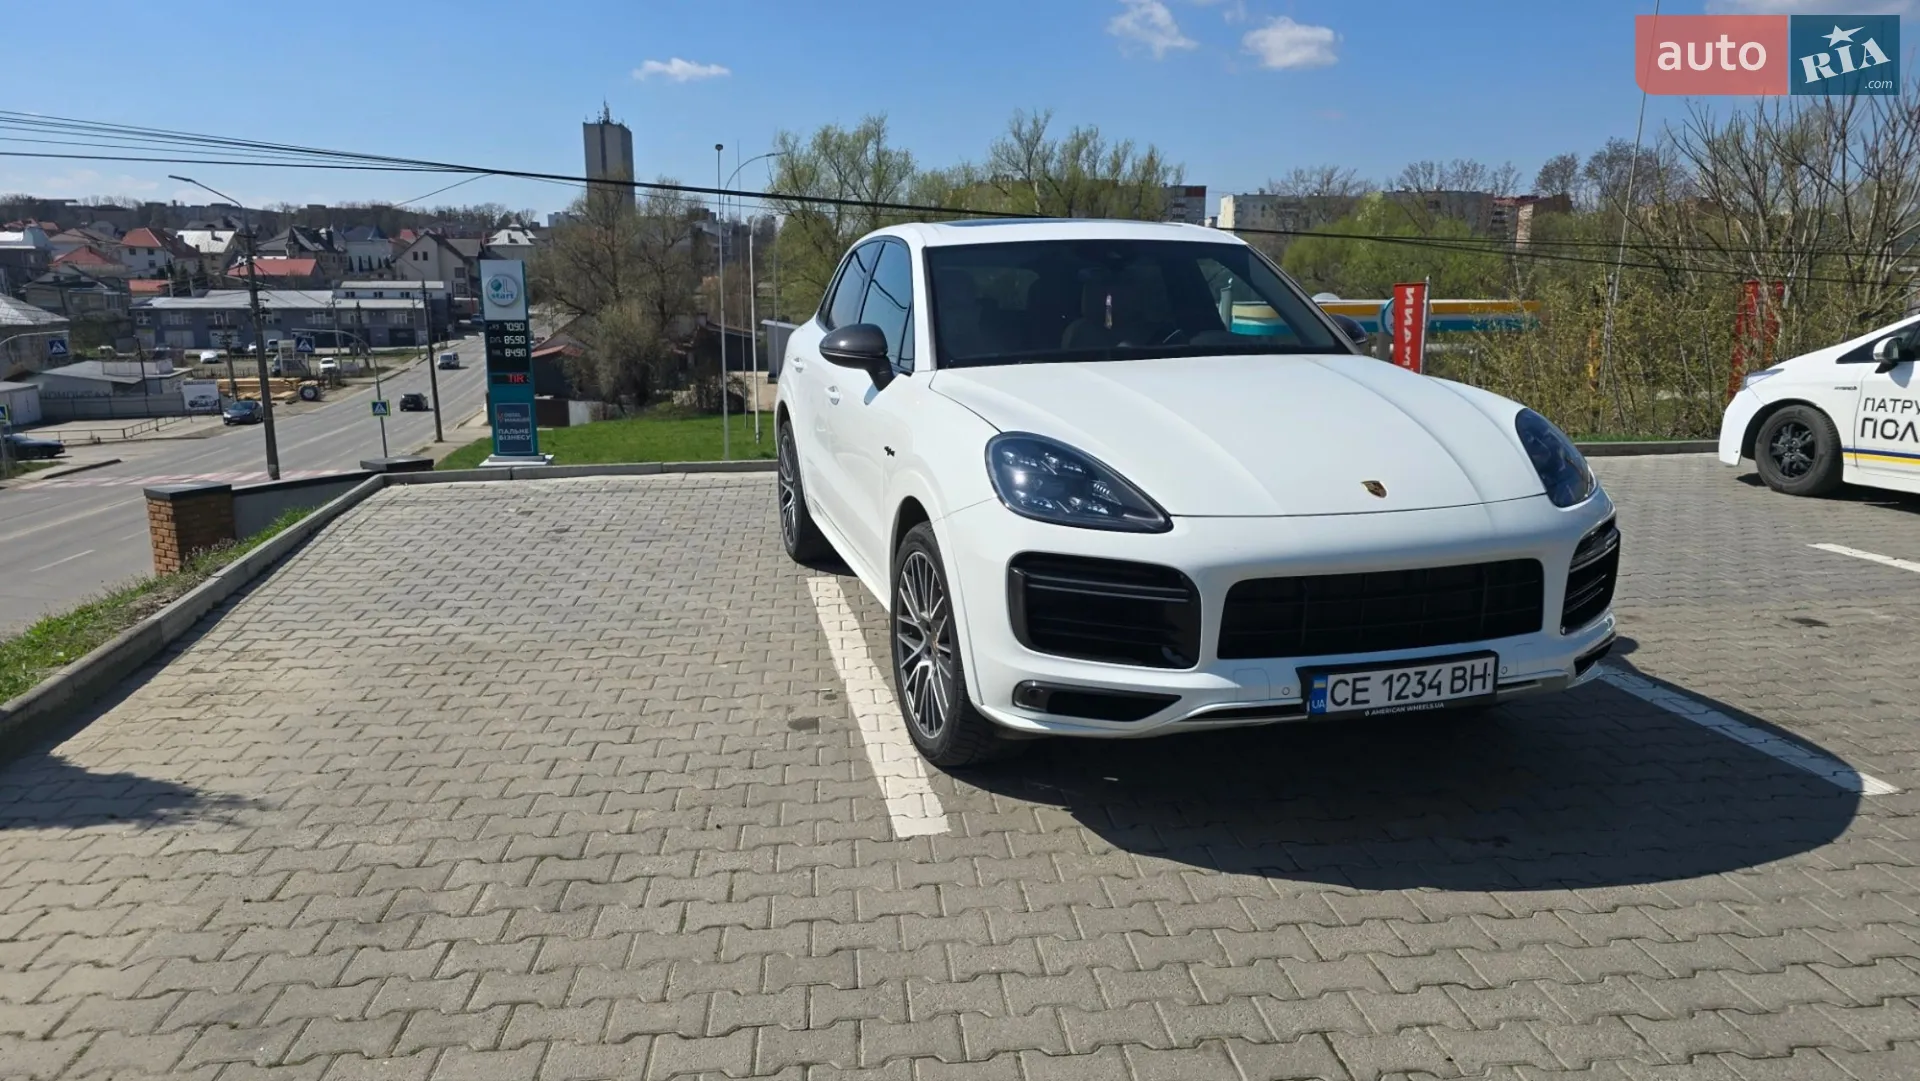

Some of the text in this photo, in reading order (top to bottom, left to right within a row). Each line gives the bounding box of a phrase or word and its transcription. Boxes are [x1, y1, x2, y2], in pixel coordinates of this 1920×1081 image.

[1861, 417, 1919, 443] ПОЛ
[1330, 662, 1488, 707] CE 1234 BH
[1312, 697, 1326, 709] UA
[1370, 706, 1405, 716] AMERICAN
